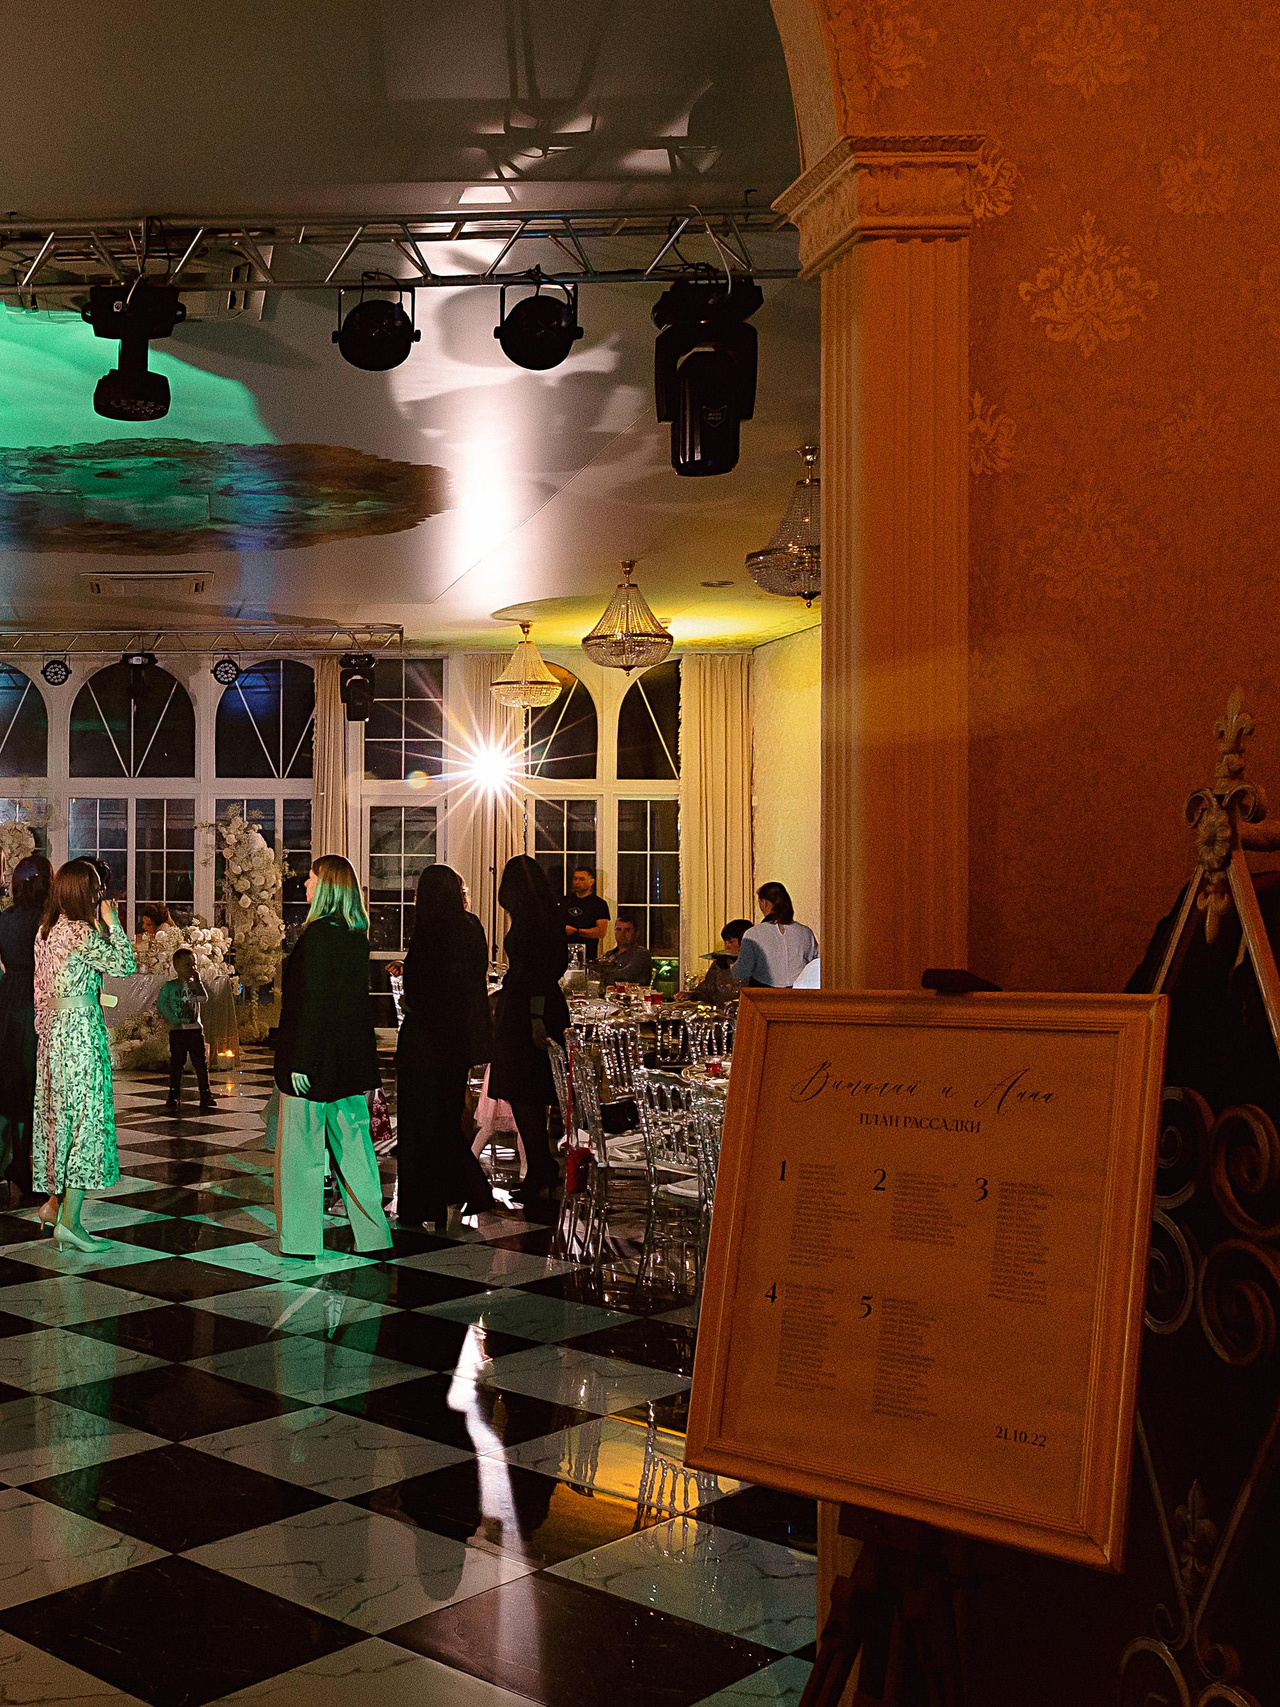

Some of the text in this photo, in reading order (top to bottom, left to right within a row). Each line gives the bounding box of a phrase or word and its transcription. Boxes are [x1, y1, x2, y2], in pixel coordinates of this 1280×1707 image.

[941, 1084, 959, 1098] и
[973, 1068, 1060, 1116] Анна
[859, 1113, 981, 1134] ПЛАН РАССАДКИ
[779, 1160, 787, 1182] 1
[872, 1168, 887, 1192] 2
[974, 1177, 989, 1202] 3
[764, 1282, 777, 1304] 4
[858, 1295, 873, 1319] 5
[994, 1426, 1047, 1448] 21.10.22
